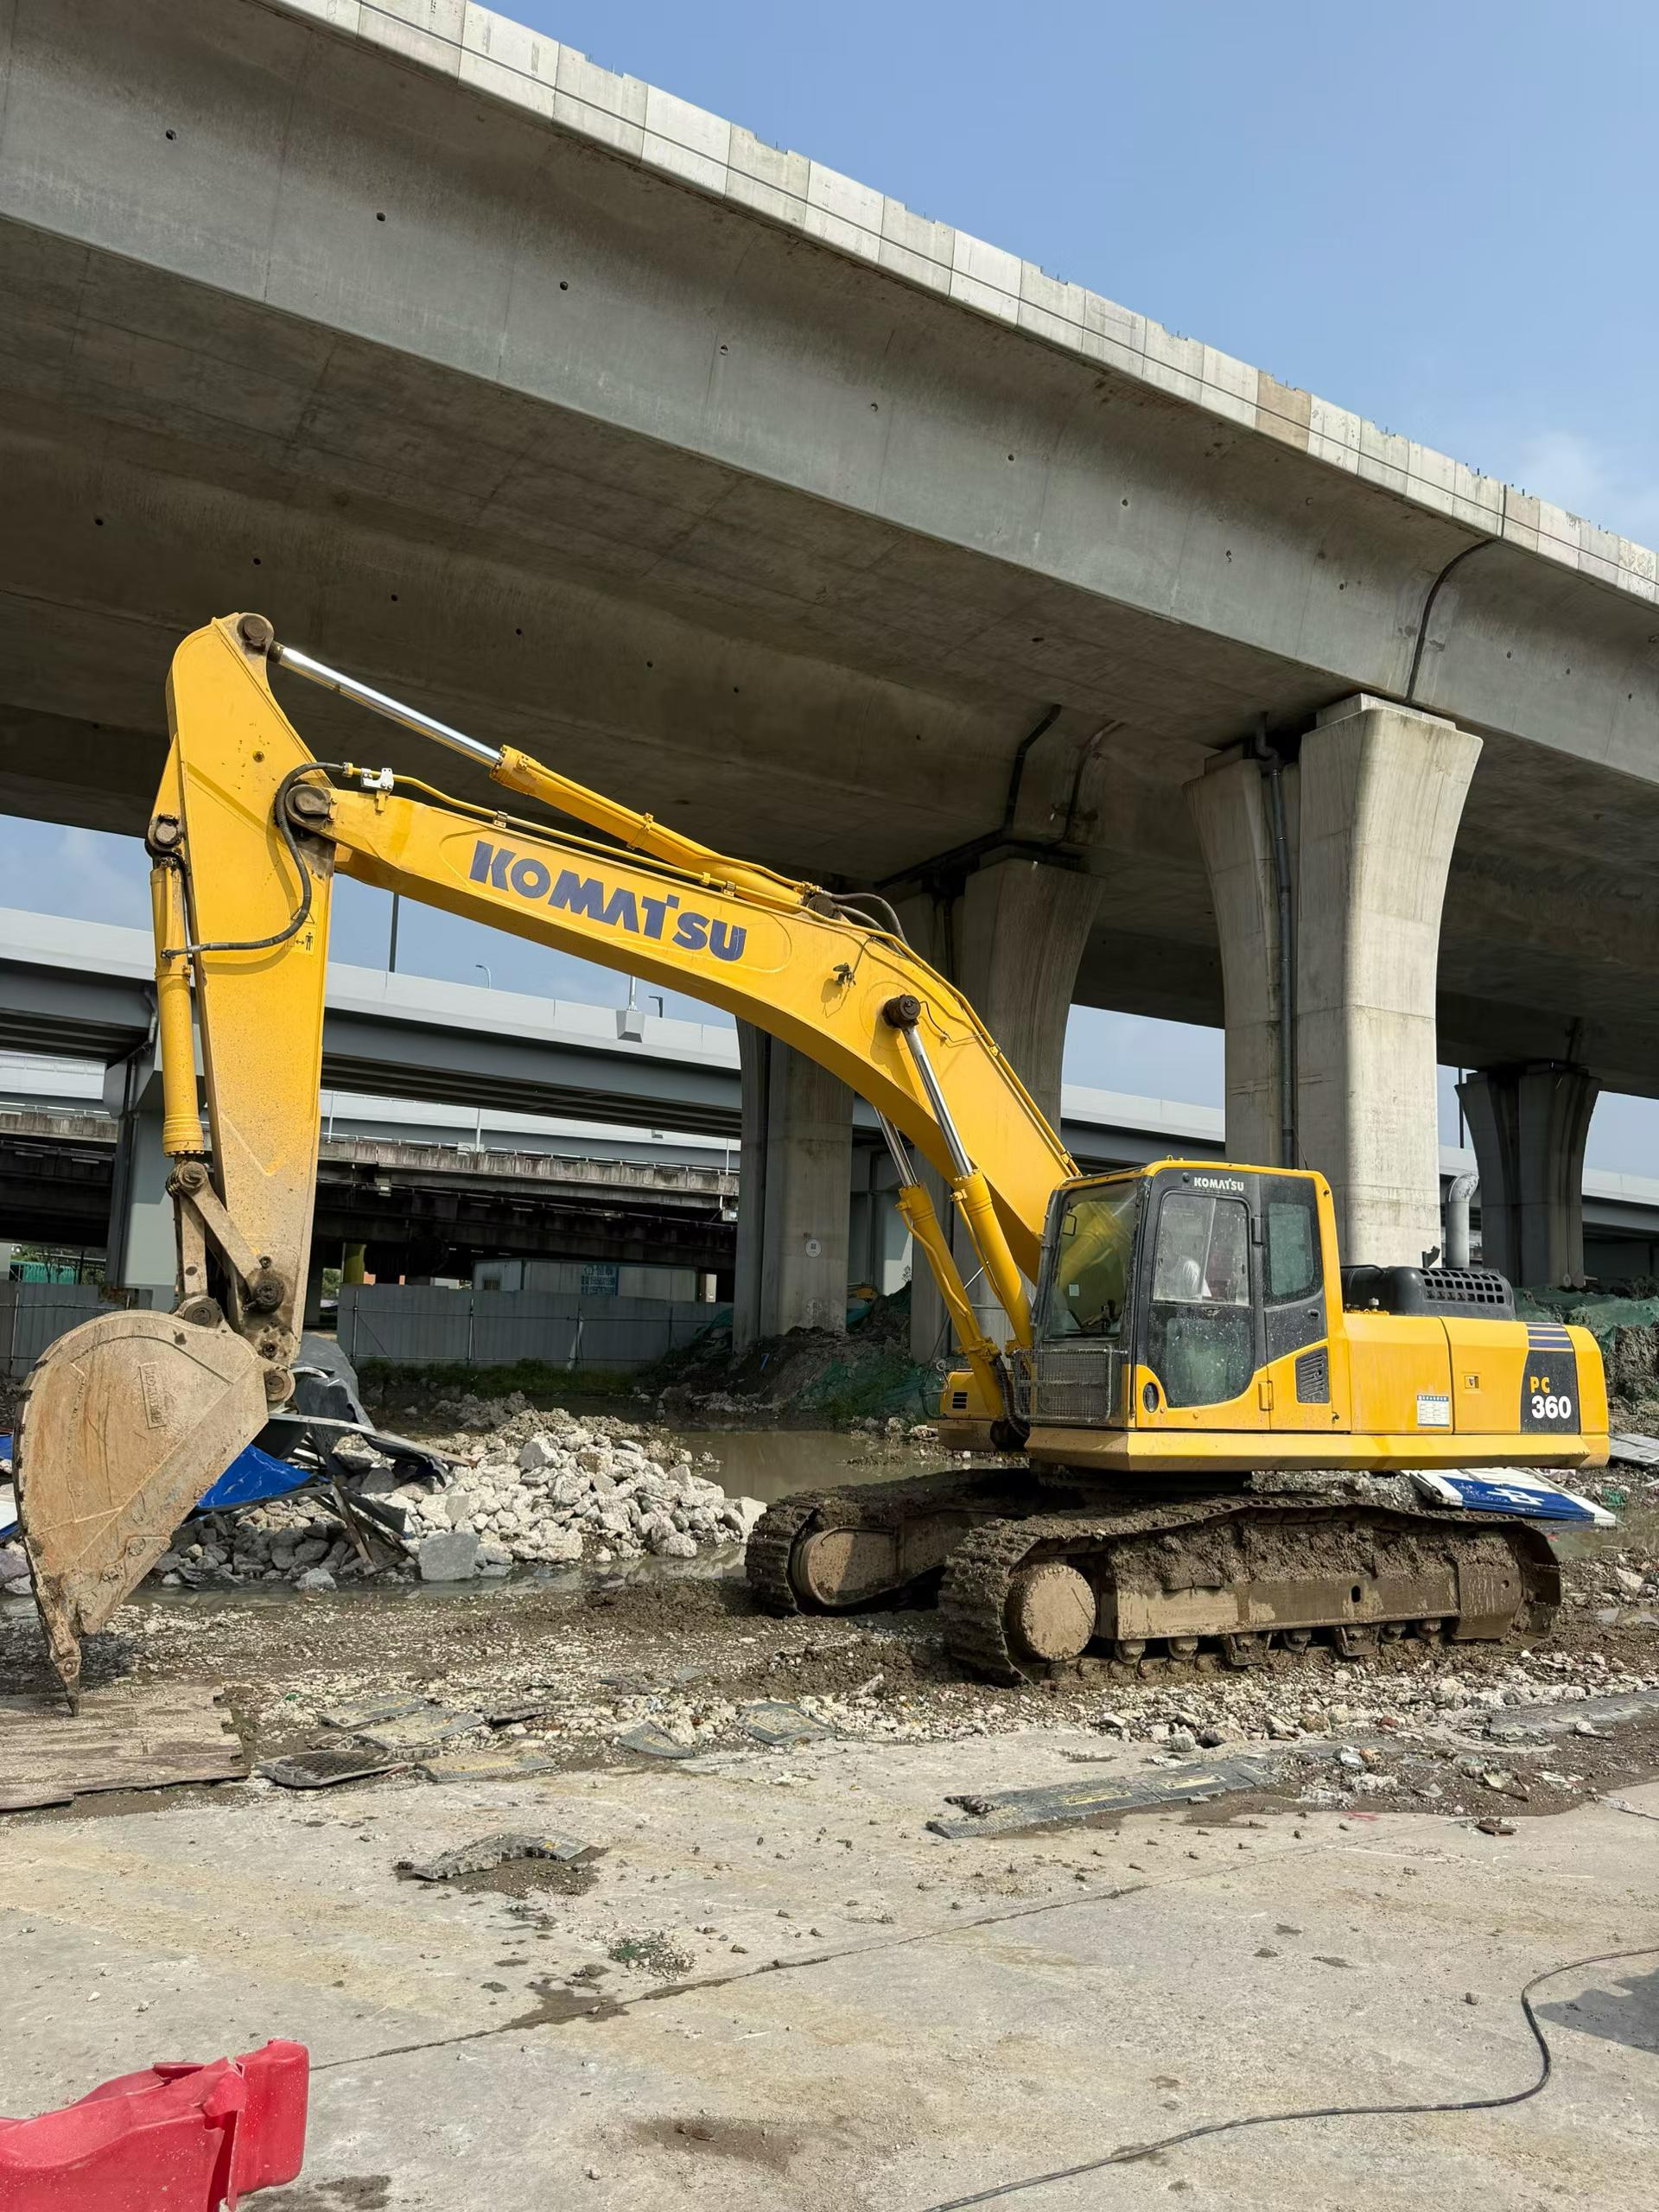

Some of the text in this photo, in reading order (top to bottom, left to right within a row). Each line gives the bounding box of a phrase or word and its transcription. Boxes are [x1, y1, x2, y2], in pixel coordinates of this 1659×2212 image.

[469, 840, 747, 961] KOMATSU
[1194, 1177, 1244, 1192] KOMATSU
[1530, 1376, 1550, 1393] PC
[1531, 1395, 1572, 1419] 360
